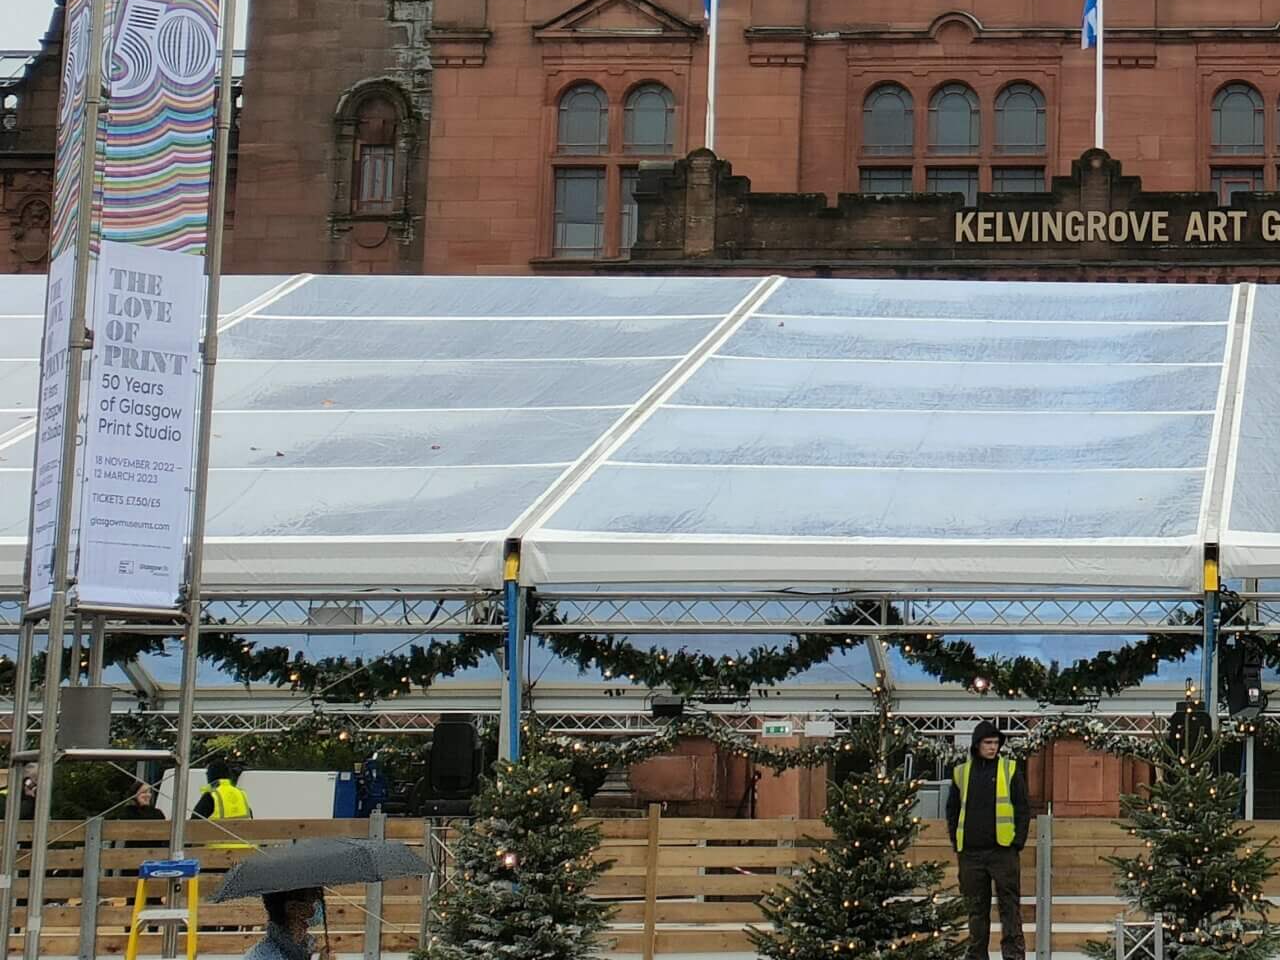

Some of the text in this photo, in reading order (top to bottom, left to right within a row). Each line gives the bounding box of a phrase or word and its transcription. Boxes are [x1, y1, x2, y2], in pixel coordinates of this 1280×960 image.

[955, 210, 1169, 243] KELVINGROVE
[1184, 211, 1248, 242] ART
[109, 267, 163, 297] THE
[107, 293, 173, 324] LOVE
[105, 319, 140, 344] OF
[103, 344, 188, 376] PRINT
[101, 373, 164, 396] 50 Years
[100, 396, 182, 421] of Glasgow
[98, 418, 182, 442] Print Studio
[104, 457, 151, 470] NOVEMBER
[104, 471, 135, 482] MARCH
[137, 474, 158, 484] 2023
[92, 492, 124, 505] TICKETS
